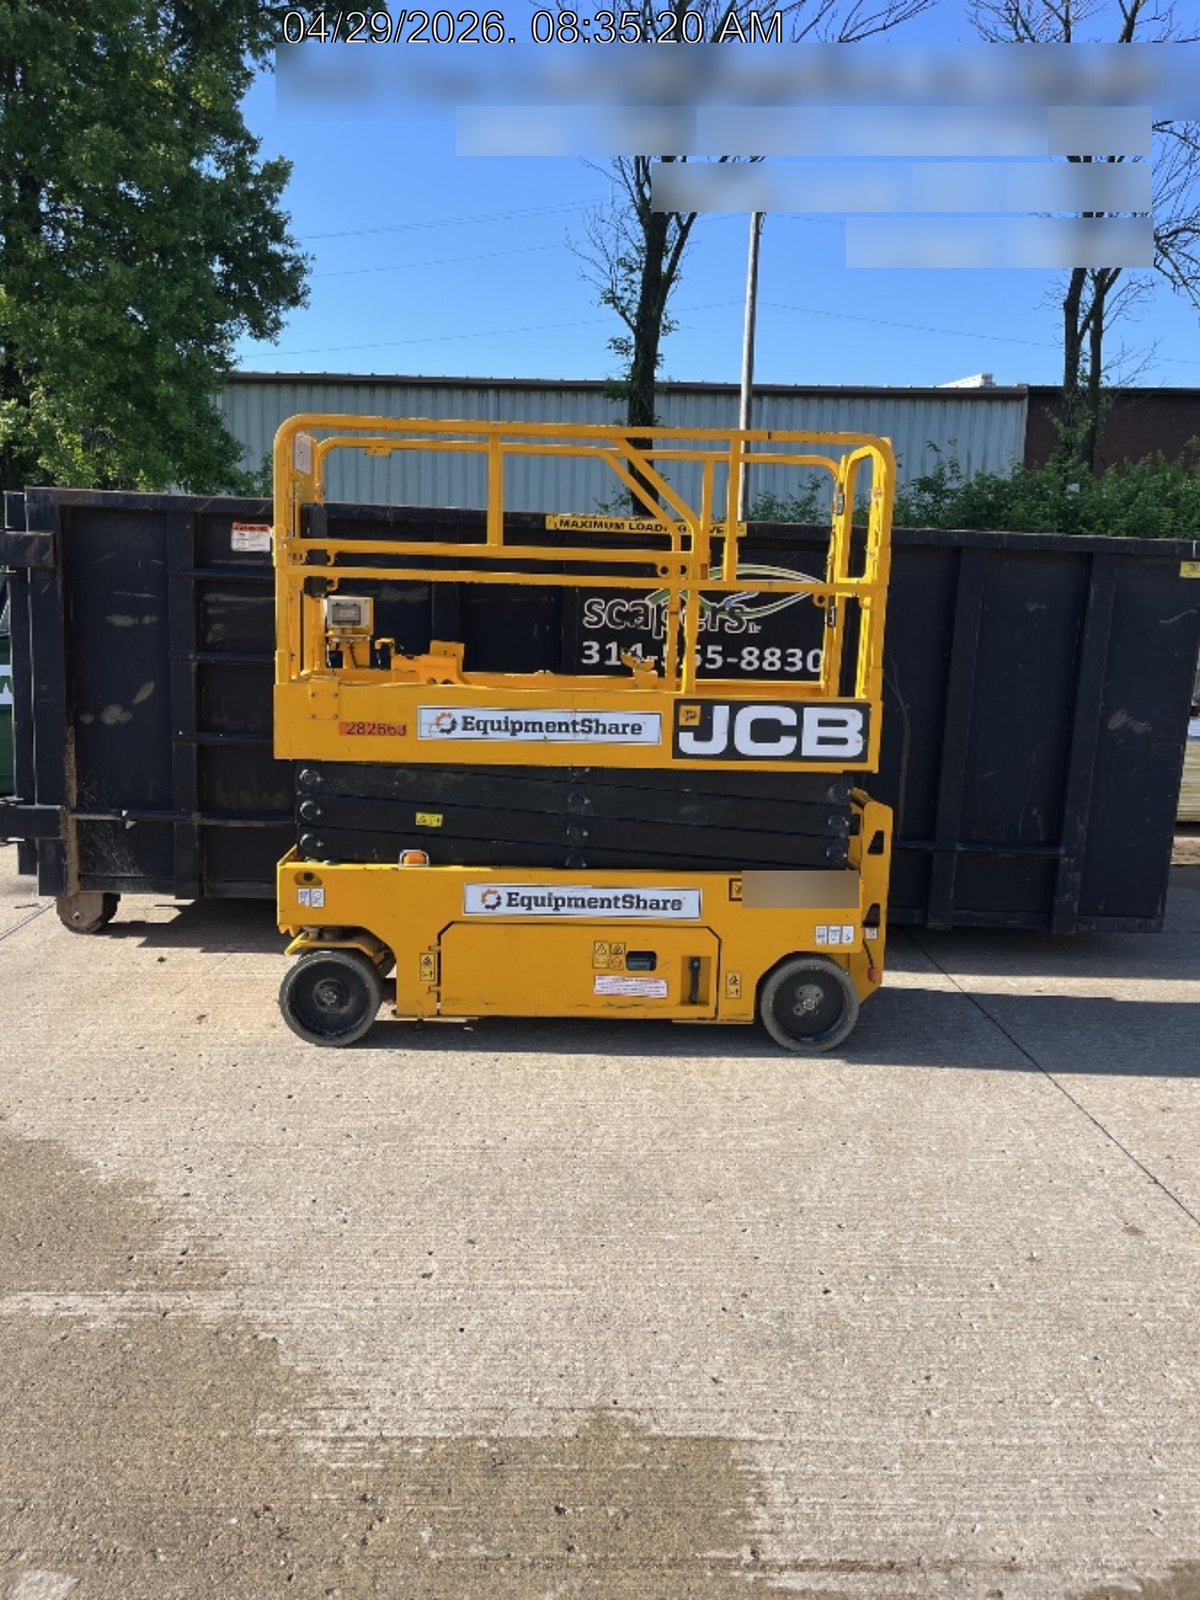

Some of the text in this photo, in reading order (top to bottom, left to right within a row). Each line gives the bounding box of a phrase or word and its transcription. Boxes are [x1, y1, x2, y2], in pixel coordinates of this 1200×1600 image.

[559, 519, 625, 530] MAXIMUM
[461, 715, 643, 736] EquipmentShare
[678, 705, 864, 758] JCB
[506, 892, 683, 911] EquipmentShare
